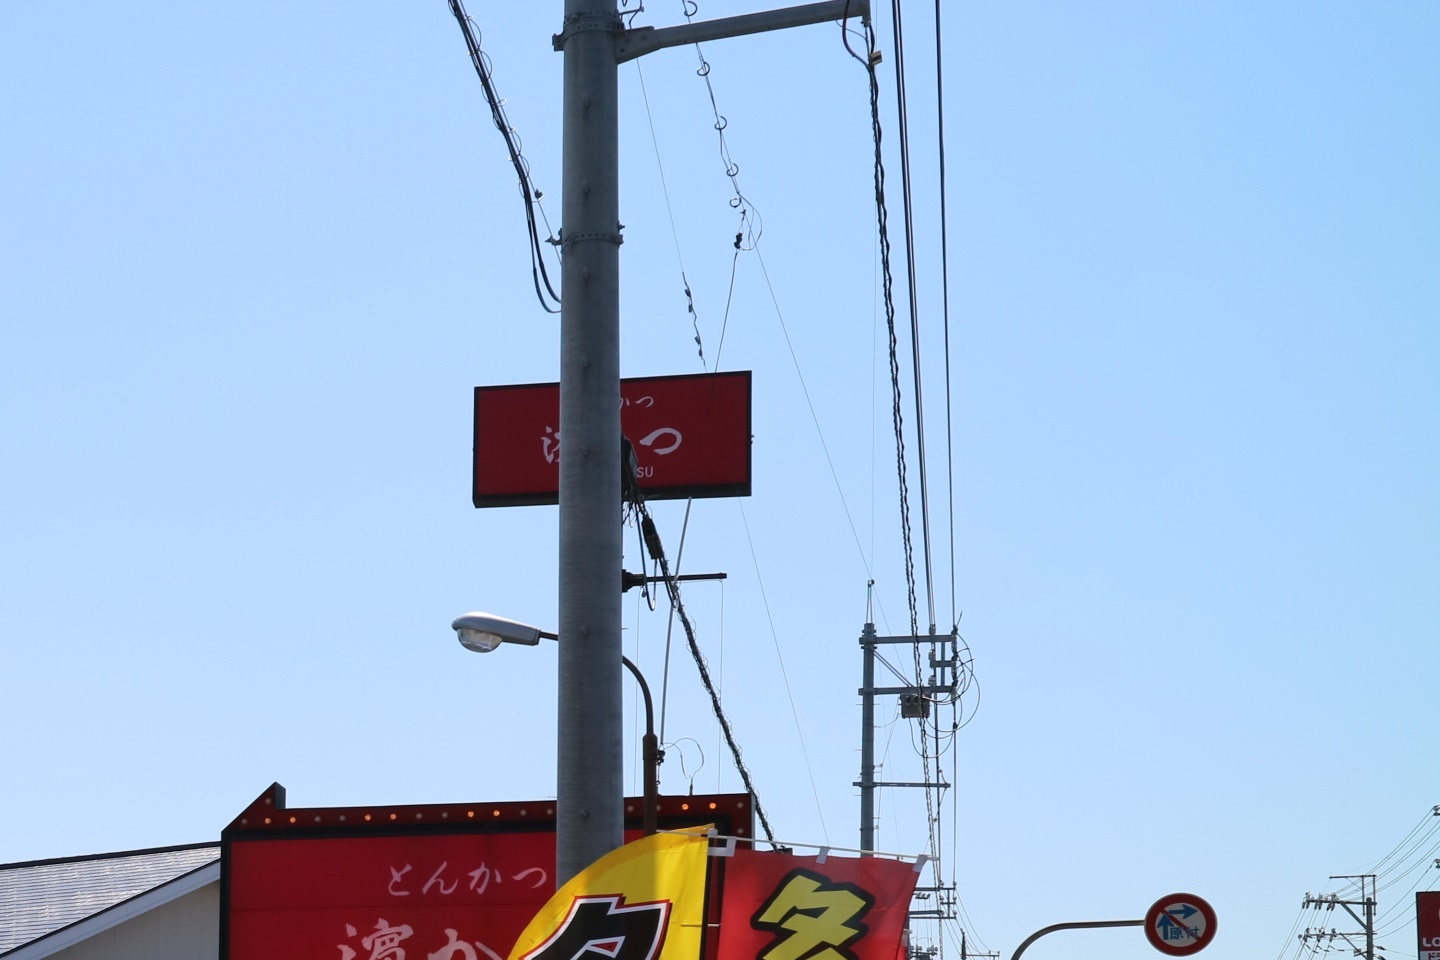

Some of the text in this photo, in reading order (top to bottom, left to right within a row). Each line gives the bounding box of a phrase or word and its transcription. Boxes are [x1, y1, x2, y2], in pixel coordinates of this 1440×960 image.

[388, 861, 547, 896] とんかつ
[1169, 926, 1201, 940] 原付
